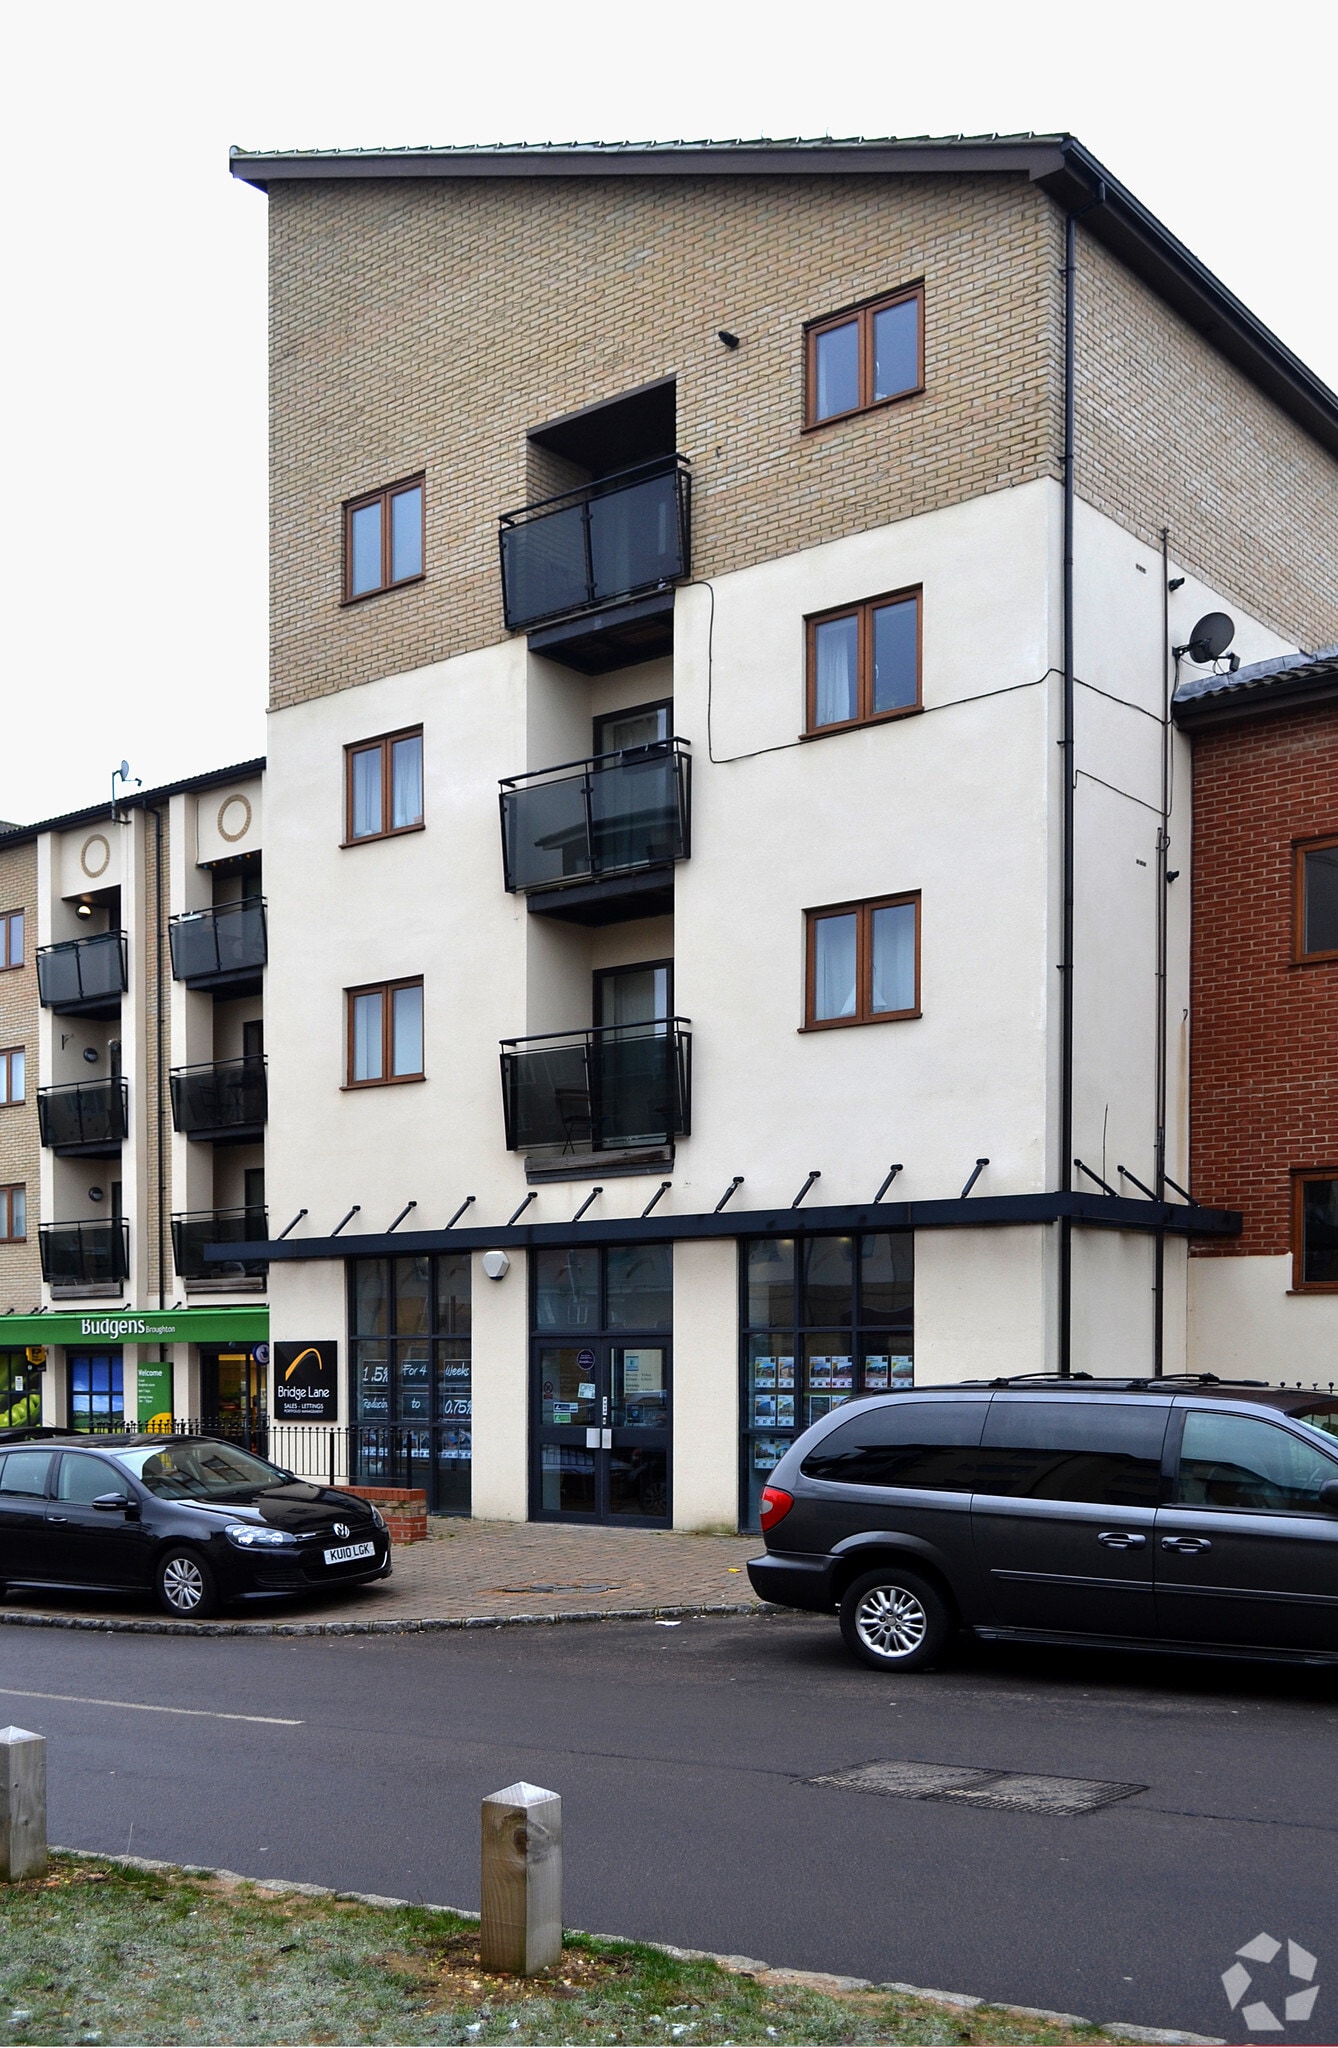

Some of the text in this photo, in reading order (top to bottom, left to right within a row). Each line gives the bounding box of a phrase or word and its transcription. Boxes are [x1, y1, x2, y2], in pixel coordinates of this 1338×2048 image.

[81, 1318, 176, 1340] Budgens Broughton
[402, 1364, 428, 1377] For 4
[445, 1362, 470, 1377] Weeks
[278, 1385, 330, 1400] Bridge Lane
[411, 1397, 421, 1409] to
[330, 1543, 370, 1561] KU10 LGK
